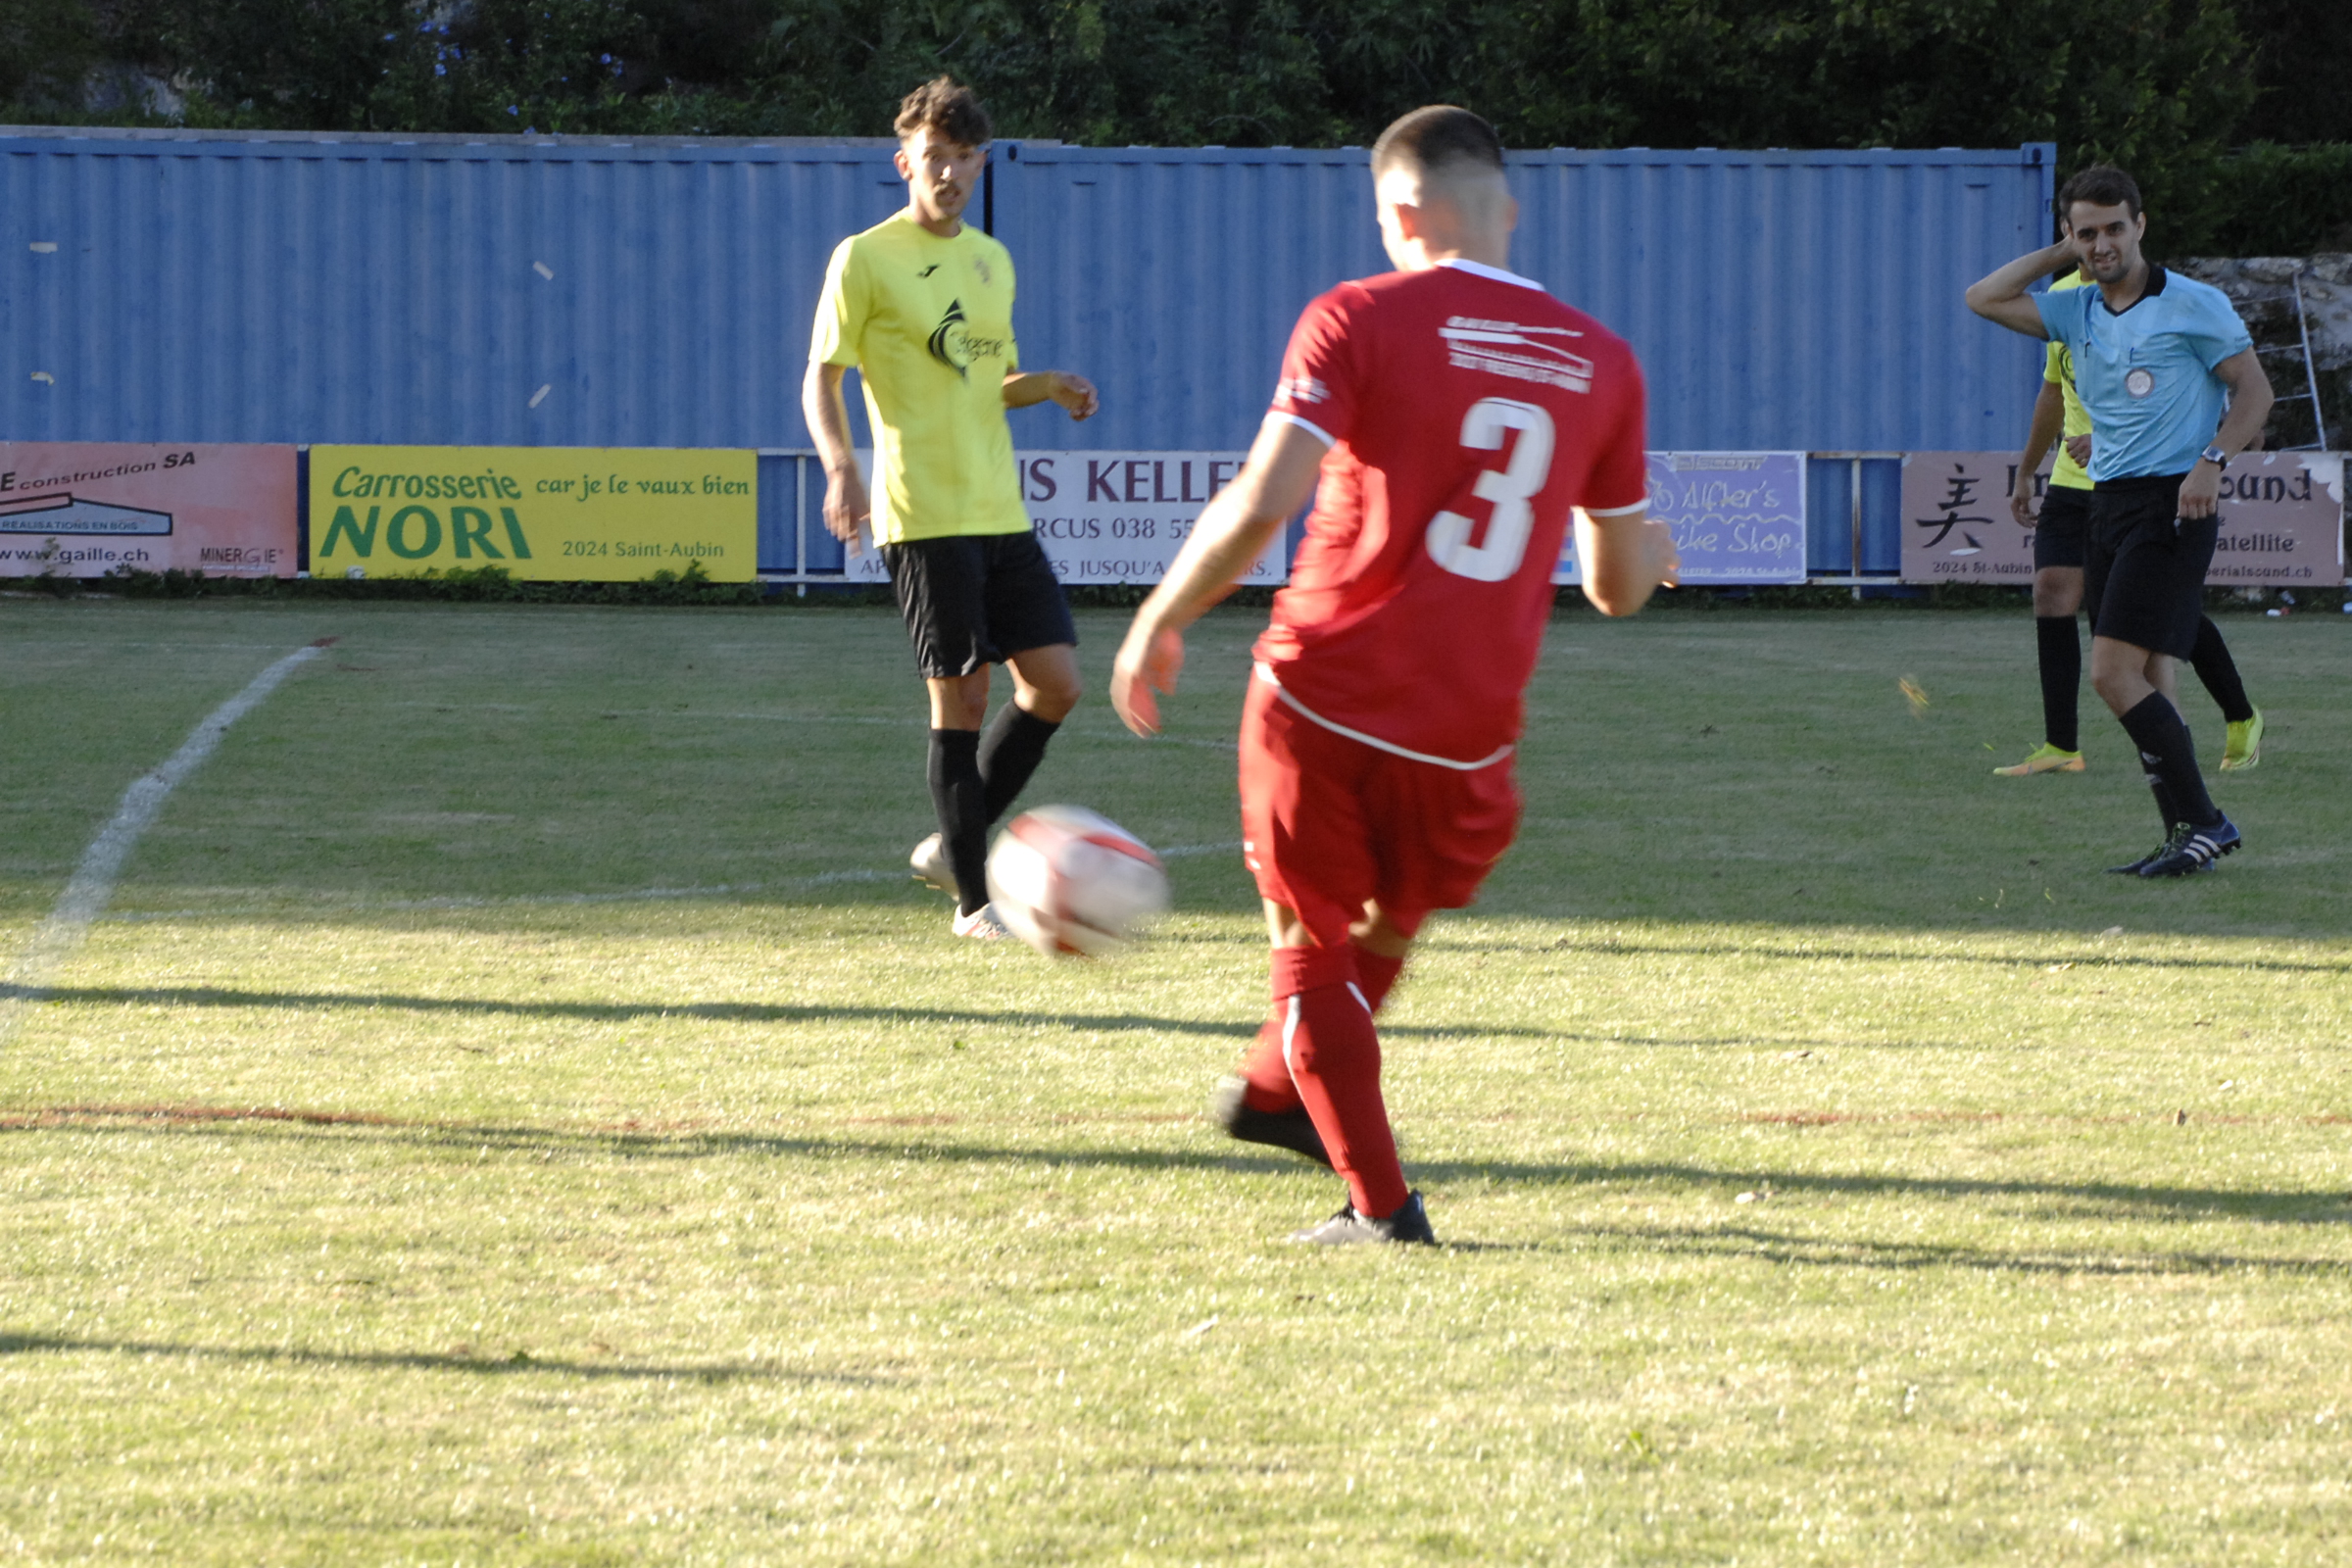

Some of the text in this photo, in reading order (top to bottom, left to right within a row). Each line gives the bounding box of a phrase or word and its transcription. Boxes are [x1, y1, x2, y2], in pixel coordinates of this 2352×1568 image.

[20, 463, 157, 490] construction
[163, 451, 196, 469] SA
[332, 466, 522, 501] Carrosserie
[536, 473, 750, 503] car je le vaux bien
[1088, 460, 1247, 503] KELLE
[1425, 396, 1556, 583] 3
[1916, 463, 1994, 549] 美
[92, 521, 107, 530] EN
[110, 521, 138, 530] BOIS
[318, 505, 532, 560] NORI
[1112, 517, 1155, 539] 038
[1727, 522, 1791, 559] Shop
[563, 541, 724, 559] 2024 Saint-Aubin
[1933, 562, 1967, 573] 2024
[1973, 562, 2033, 573] St-Aubin
[1080, 560, 1164, 578] JUSQU'A
